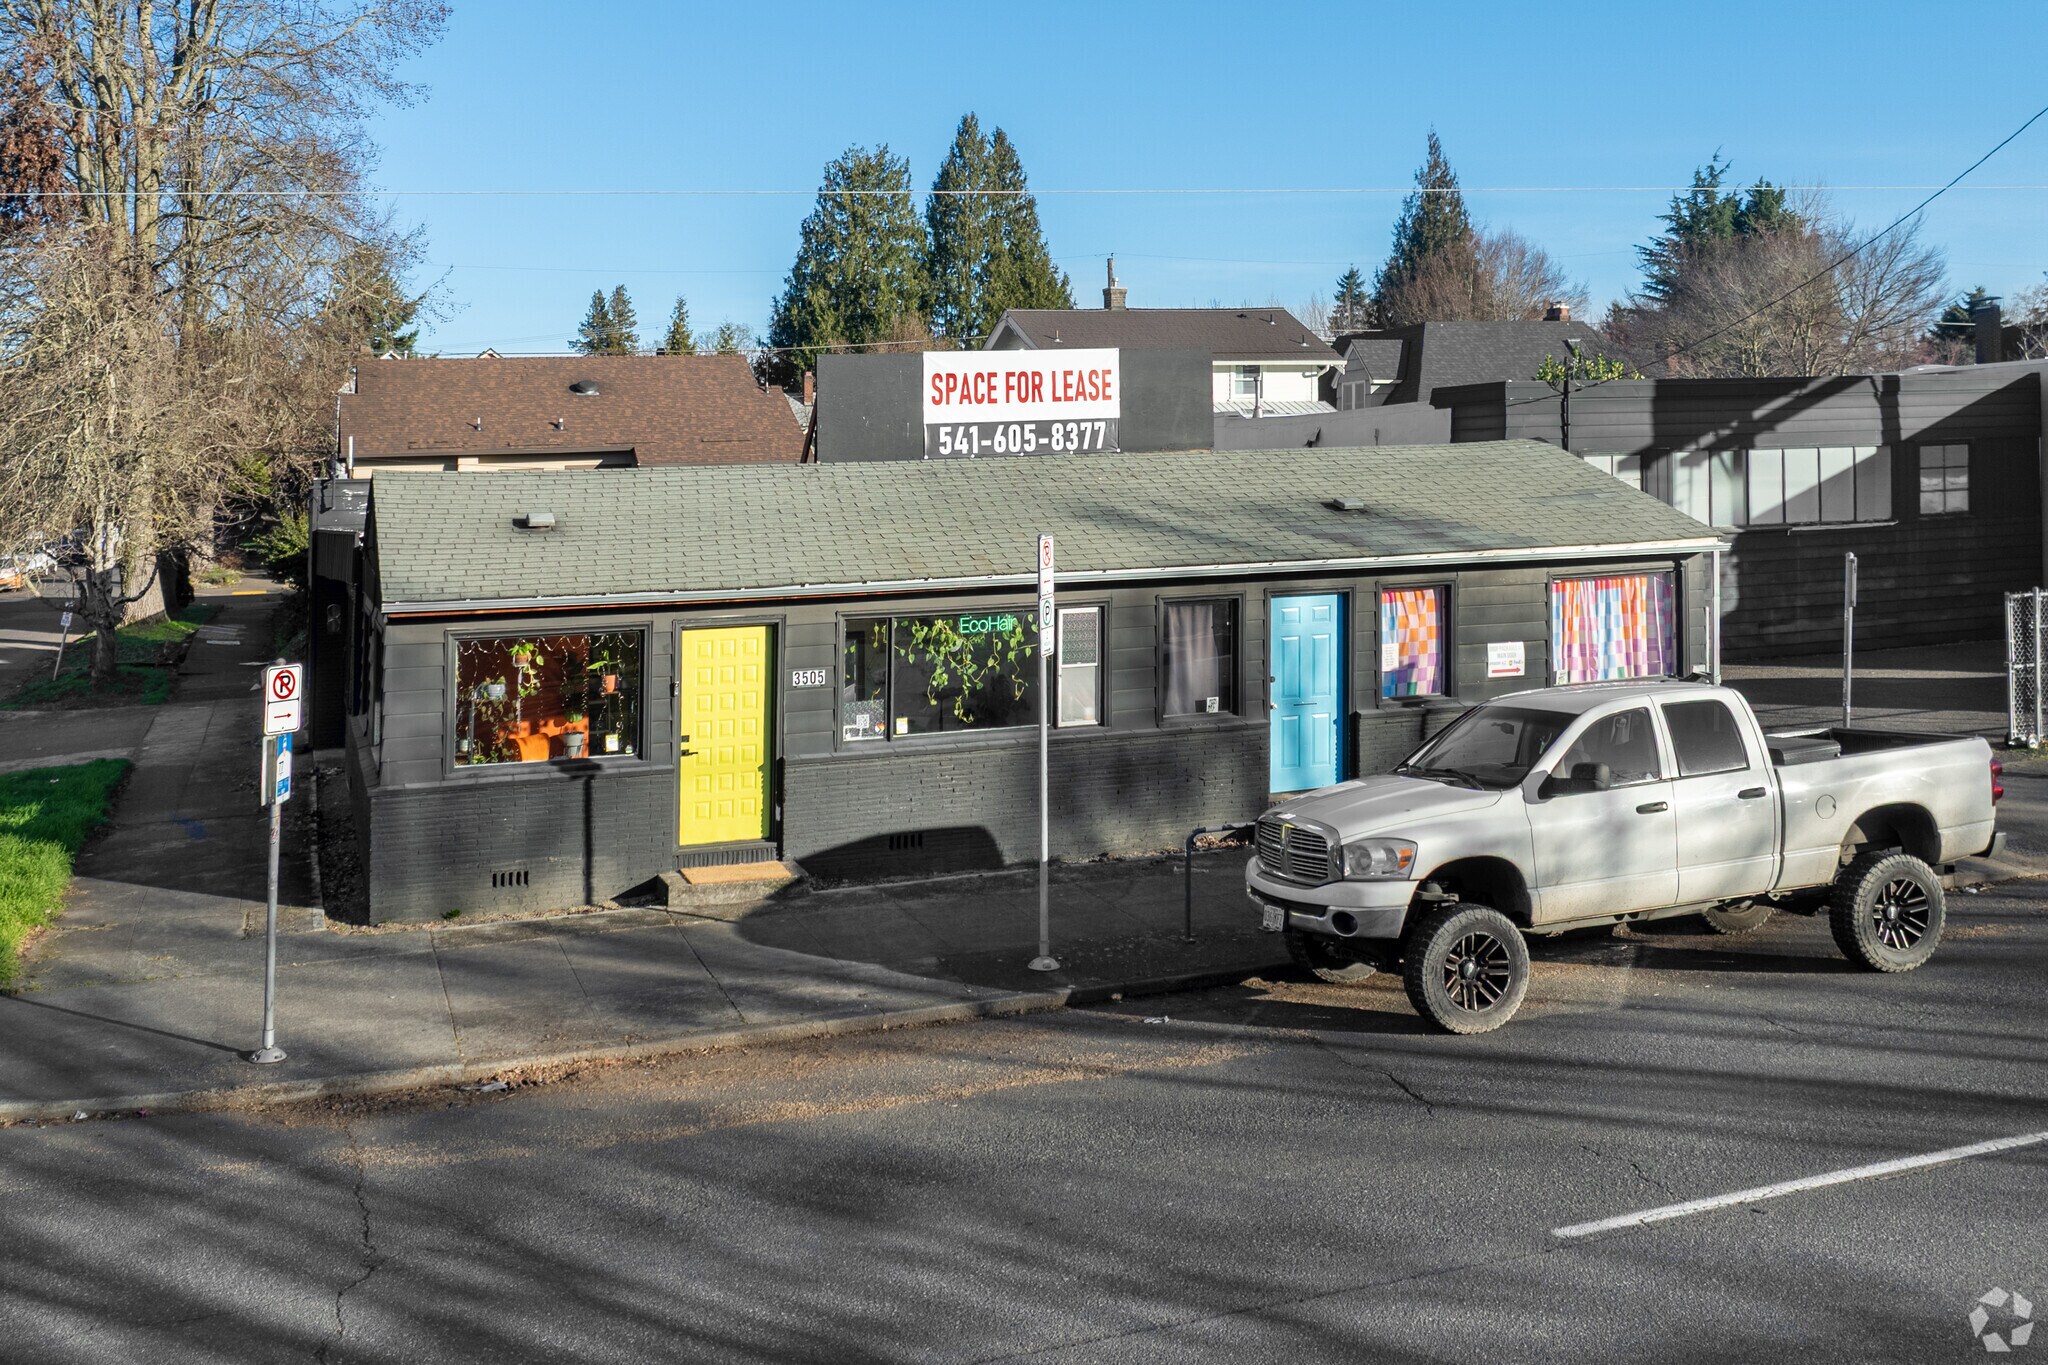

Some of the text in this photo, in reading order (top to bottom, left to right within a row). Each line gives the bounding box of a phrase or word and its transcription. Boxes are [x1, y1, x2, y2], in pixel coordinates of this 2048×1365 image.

[931, 369, 1112, 406] SPACE FOR LEASE
[938, 421, 1107, 455] 541-605-8377
[960, 614, 1015, 633] EcoHair
[794, 671, 824, 685] 3505
